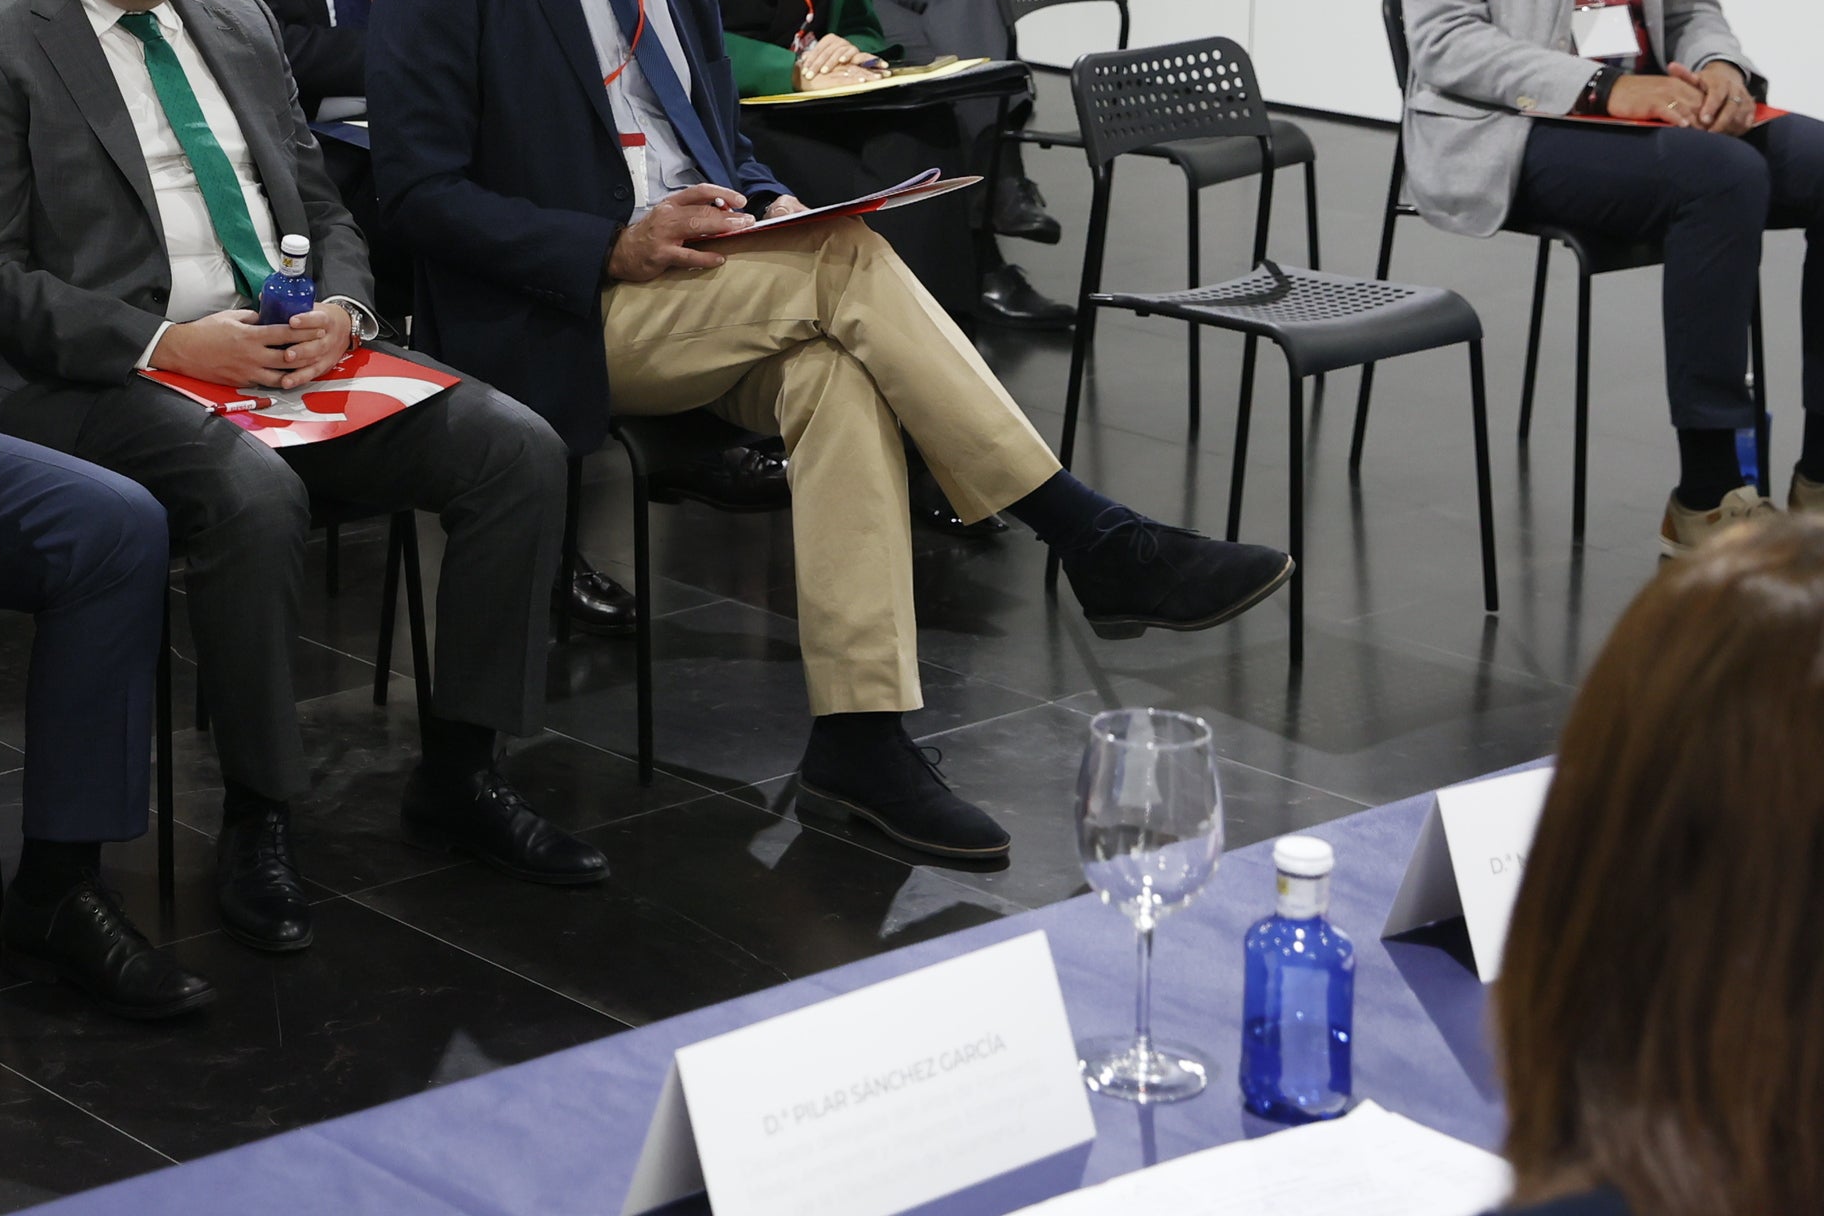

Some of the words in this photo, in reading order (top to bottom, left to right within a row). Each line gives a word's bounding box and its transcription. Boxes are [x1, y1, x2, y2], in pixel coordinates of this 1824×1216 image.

[791, 1088, 848, 1125] PILAR
[849, 1056, 938, 1105] SÁNCHEZ
[938, 1031, 1008, 1073] GARCÍA
